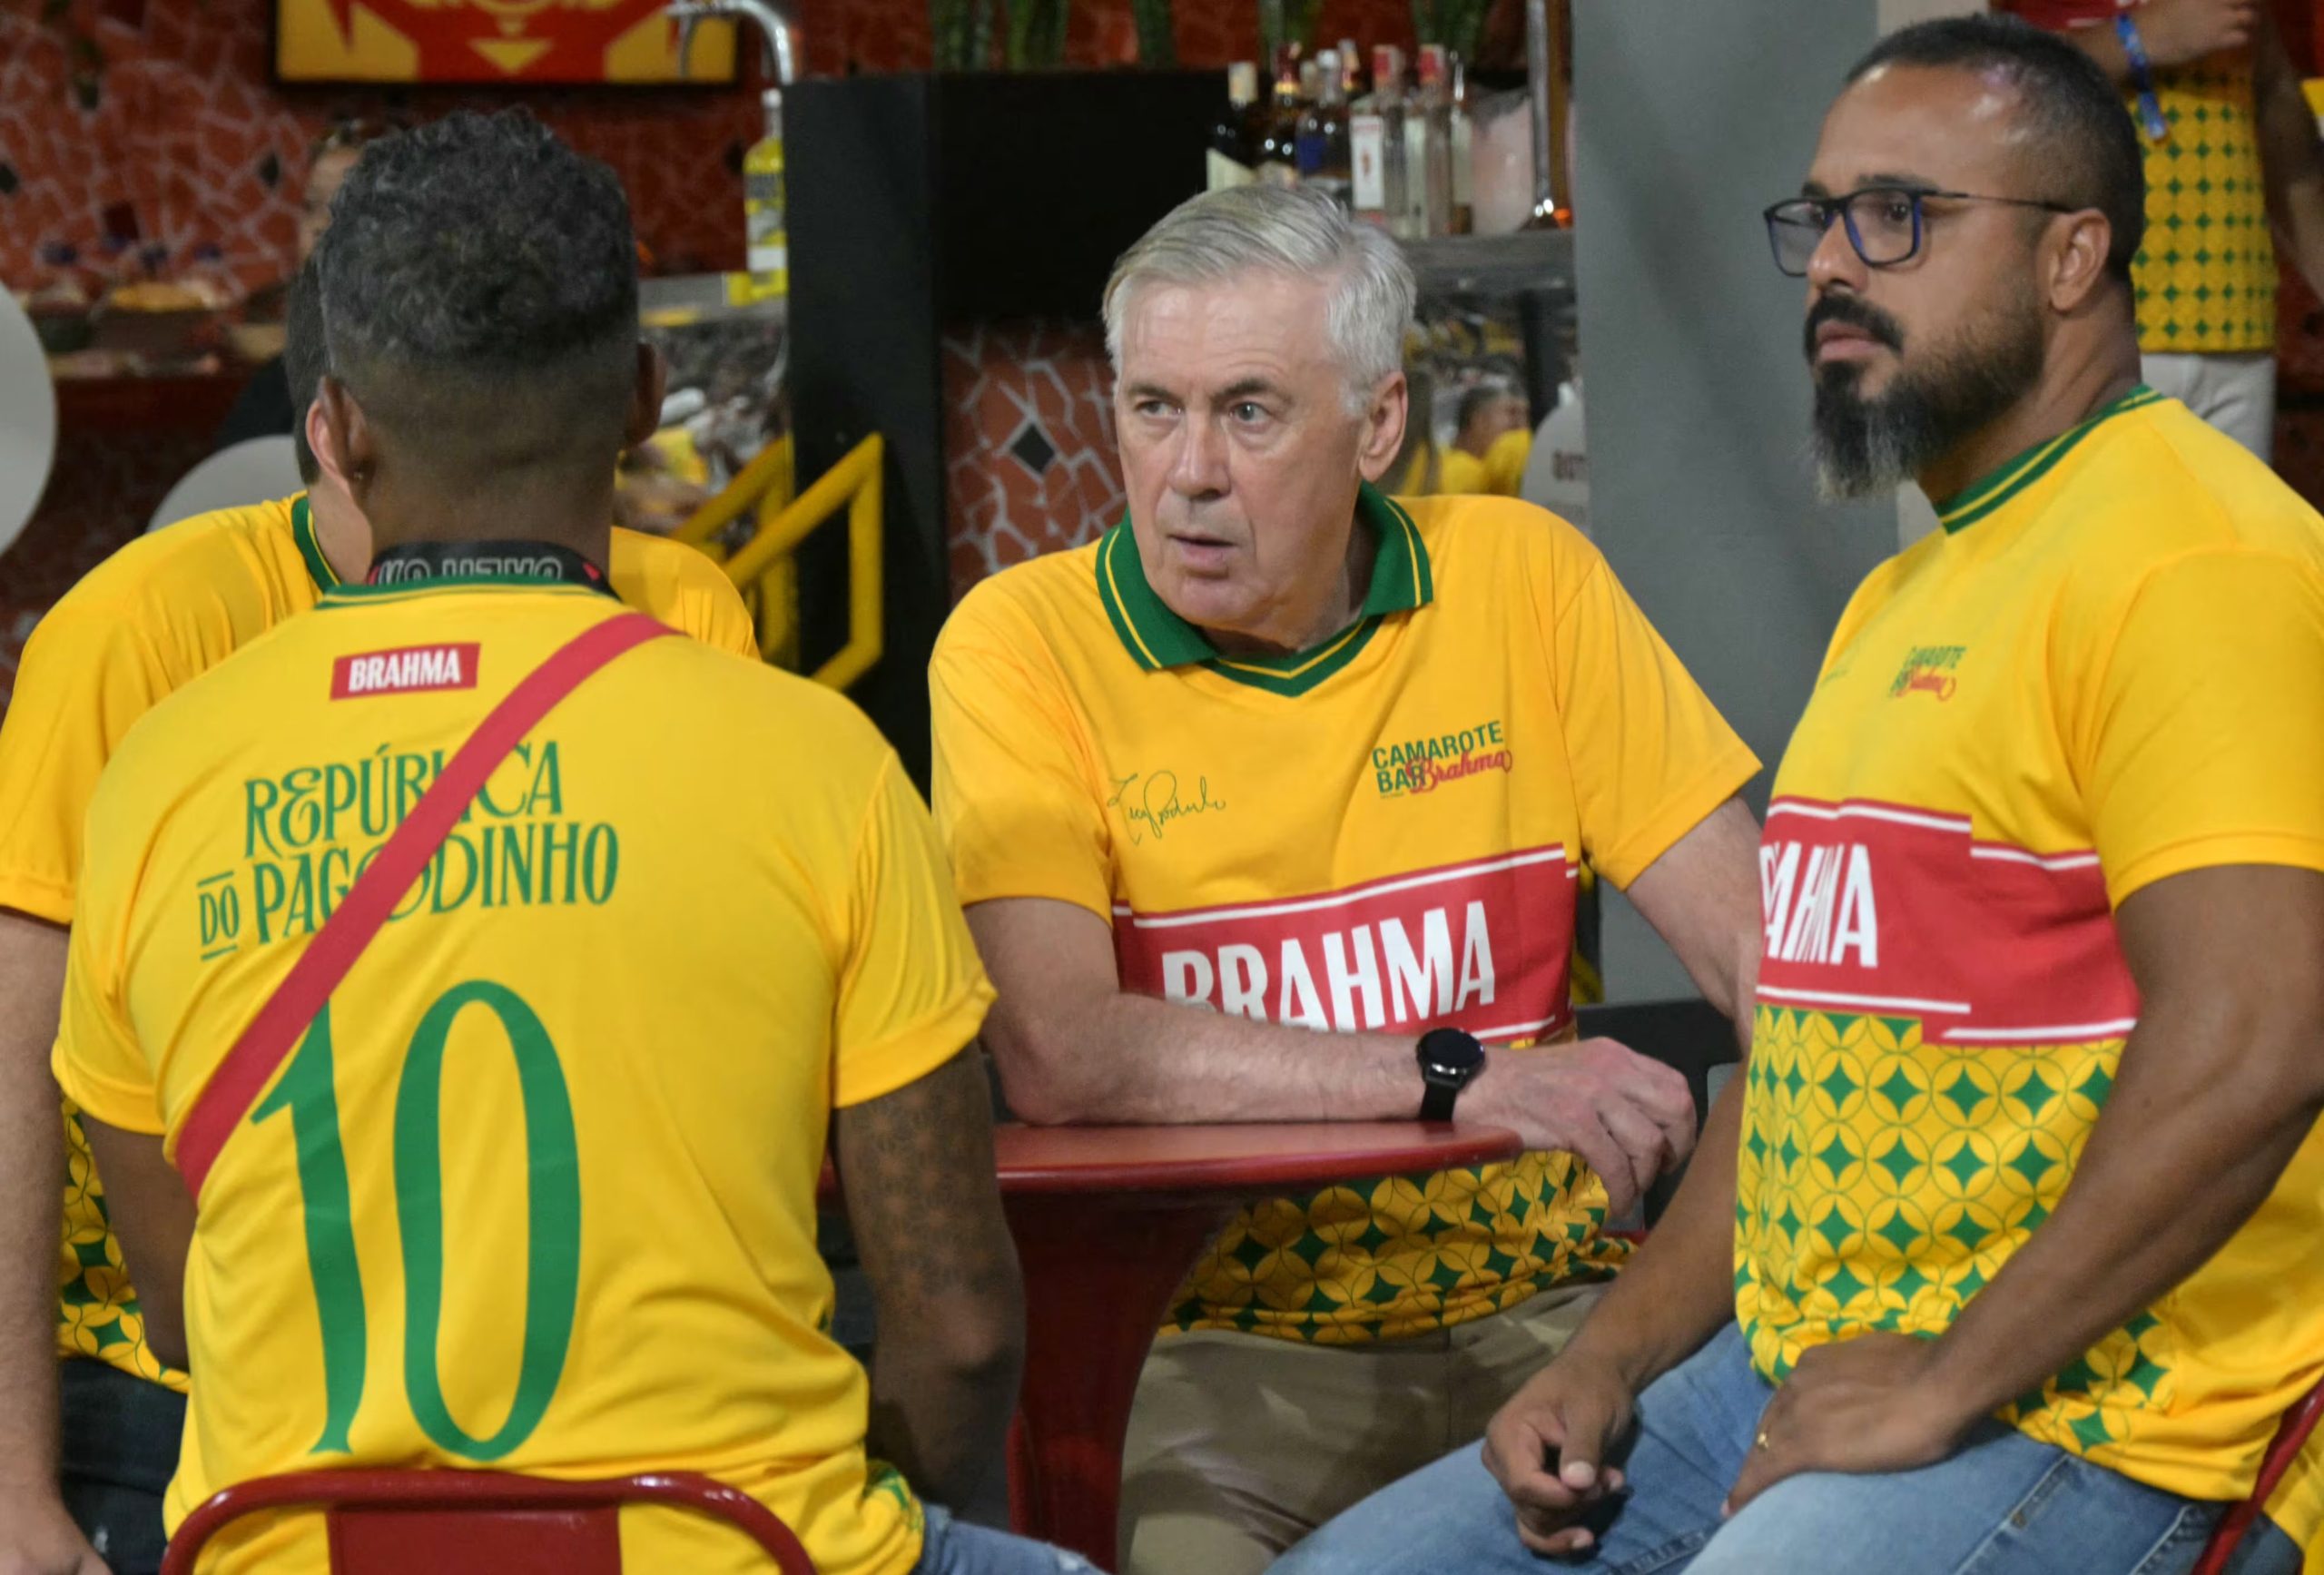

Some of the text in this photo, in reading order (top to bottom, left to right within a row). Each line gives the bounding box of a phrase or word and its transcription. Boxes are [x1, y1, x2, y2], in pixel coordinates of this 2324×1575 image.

[349, 648, 461, 693] BRAHMA
[1372, 720, 1503, 770] CAMAROTE
[1376, 748, 1513, 795] BAR Brahma
[244, 741, 563, 860] REPÚBCA
[198, 883, 241, 948] DO
[1162, 901, 1496, 1034] BRAHMA
[250, 979, 581, 1462] 10
